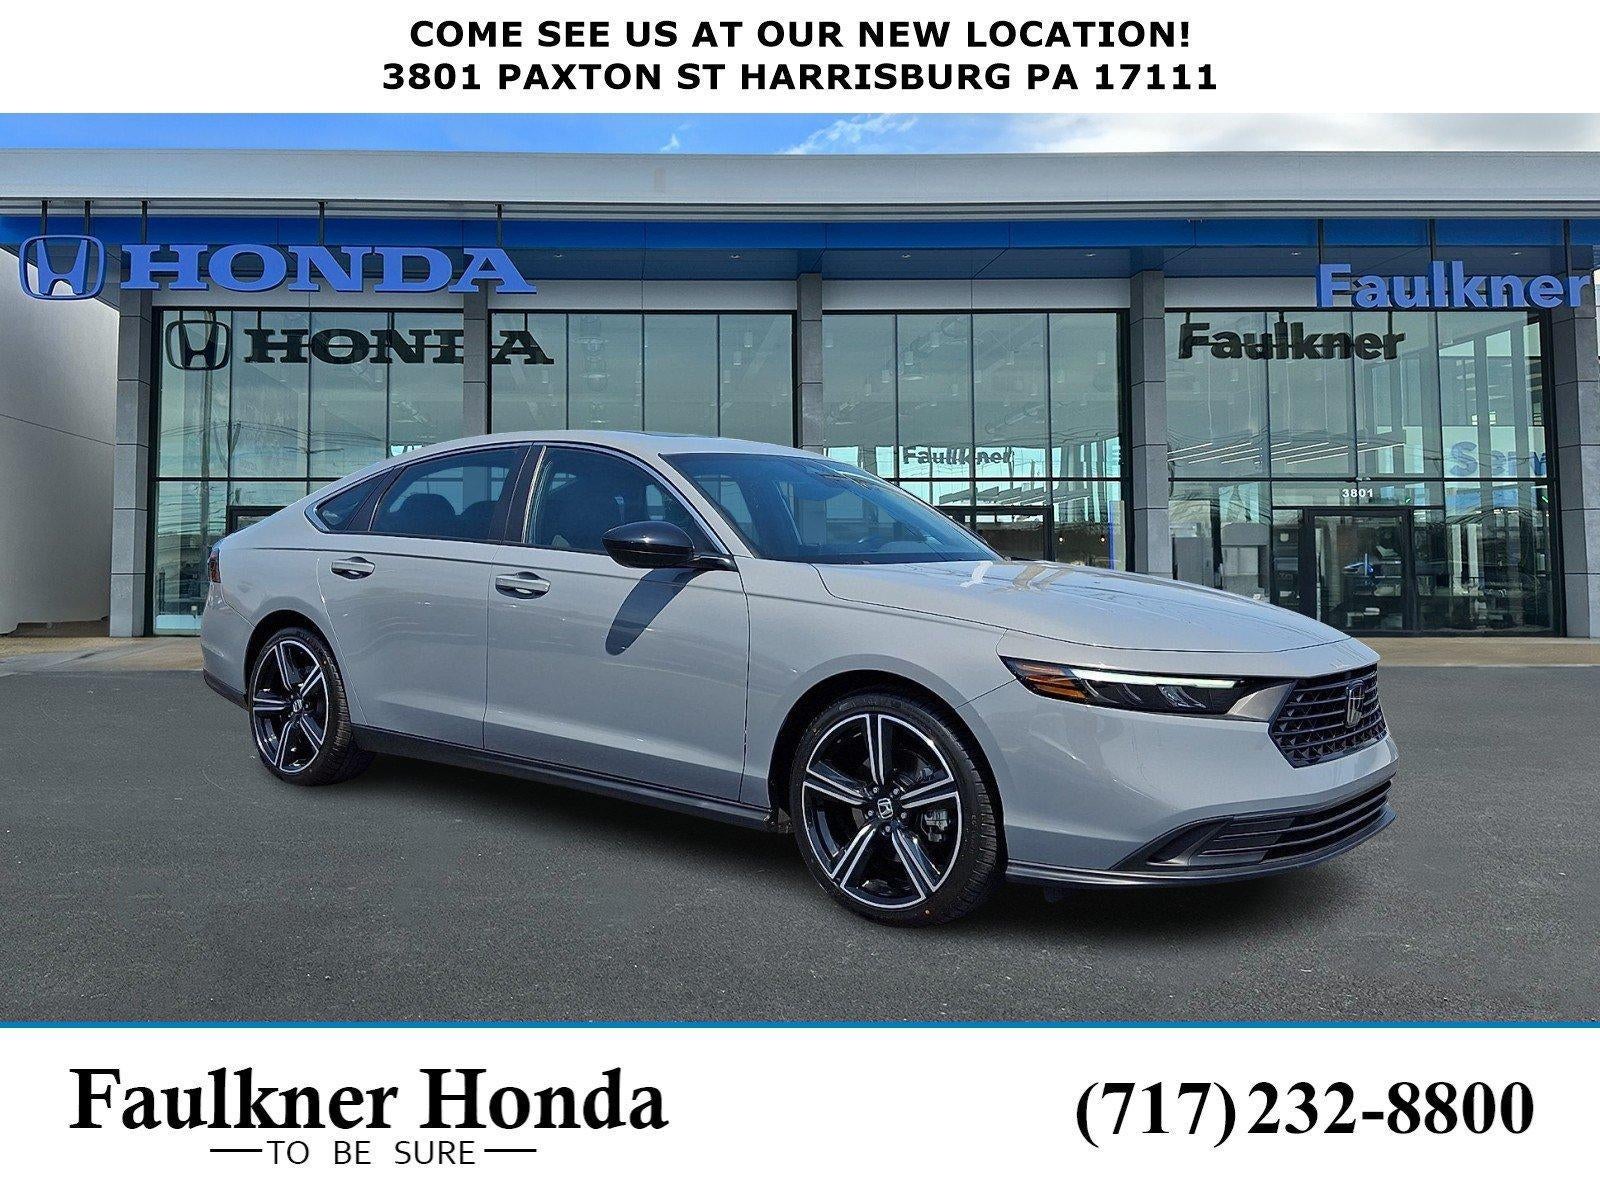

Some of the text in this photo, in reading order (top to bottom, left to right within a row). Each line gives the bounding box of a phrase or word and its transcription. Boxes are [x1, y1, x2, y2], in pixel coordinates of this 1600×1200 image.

[120, 244, 537, 294] HONDA
[1317, 260, 1592, 308] Faulkner
[1178, 321, 1406, 361] Faulkner
[1341, 488, 1374, 499] 3801
